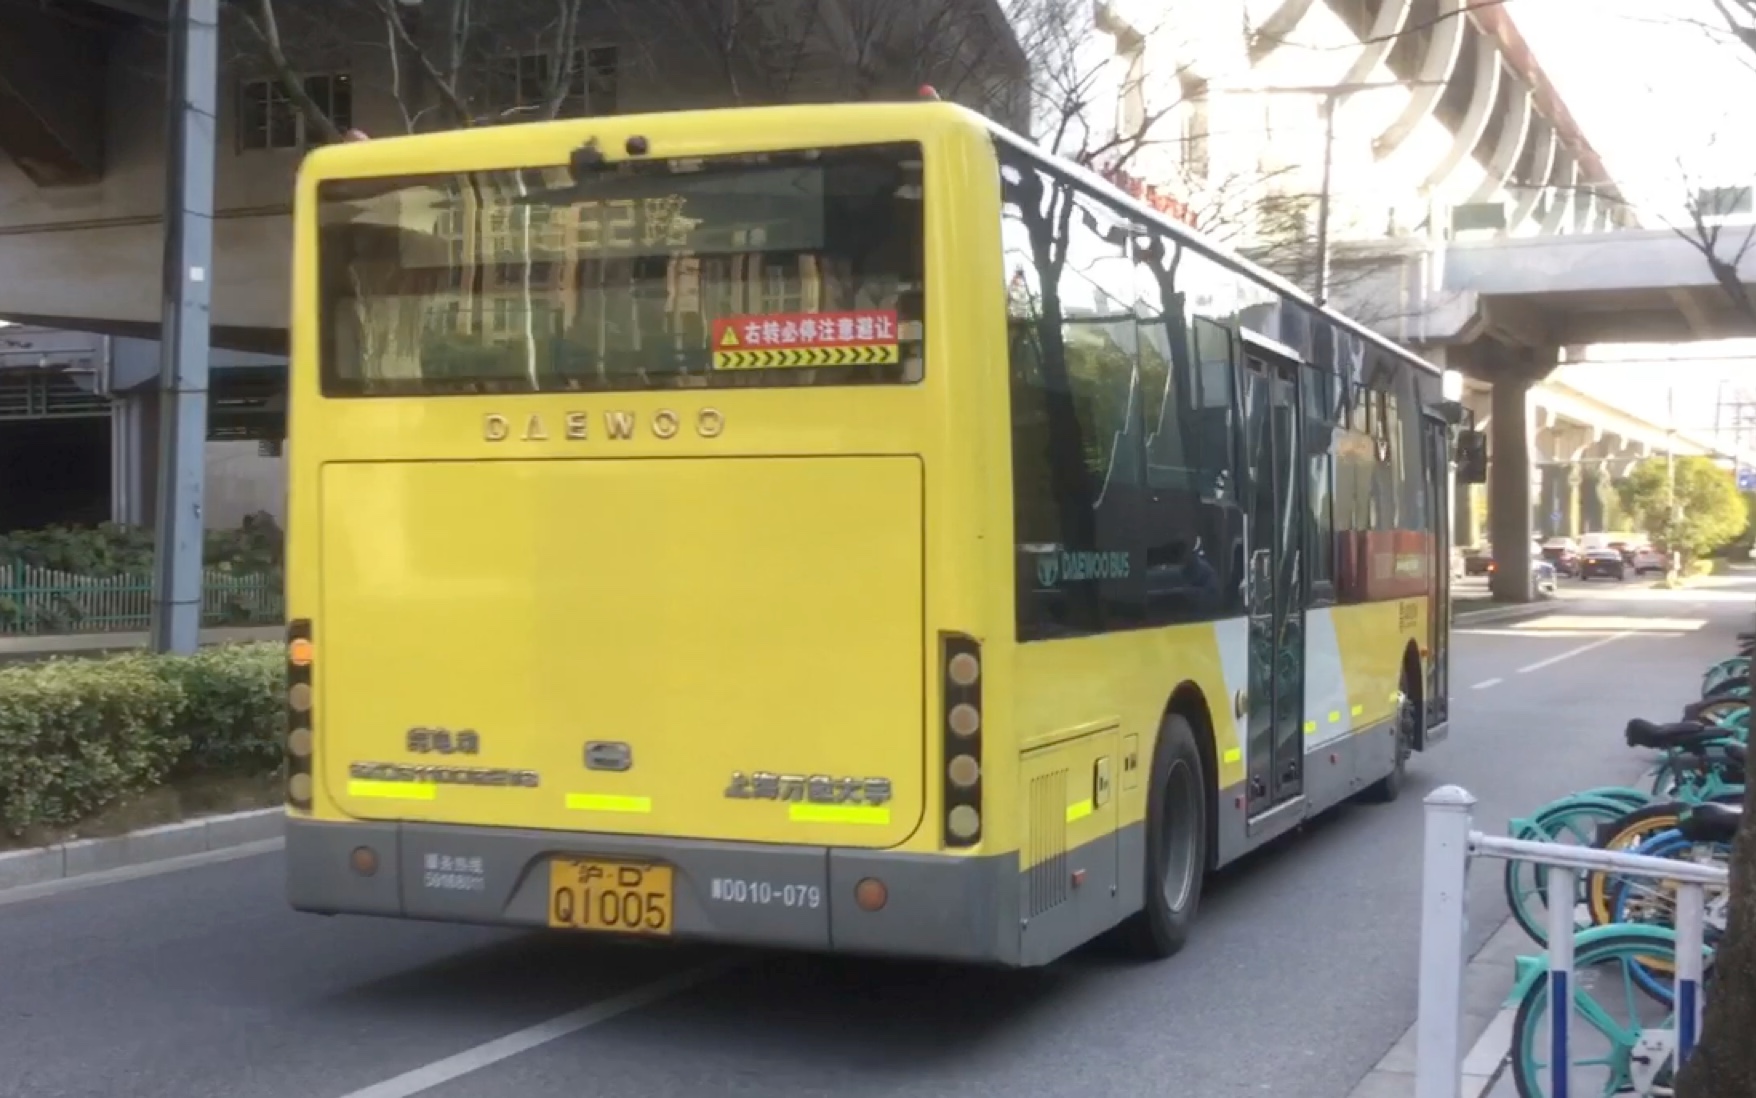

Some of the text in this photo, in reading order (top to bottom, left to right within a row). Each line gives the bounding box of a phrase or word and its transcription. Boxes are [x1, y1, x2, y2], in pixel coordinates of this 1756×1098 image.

[744, 315, 894, 345] 右转必停注意避让
[484, 407, 725, 442] DAEWOO
[554, 886, 666, 929] Q1005
